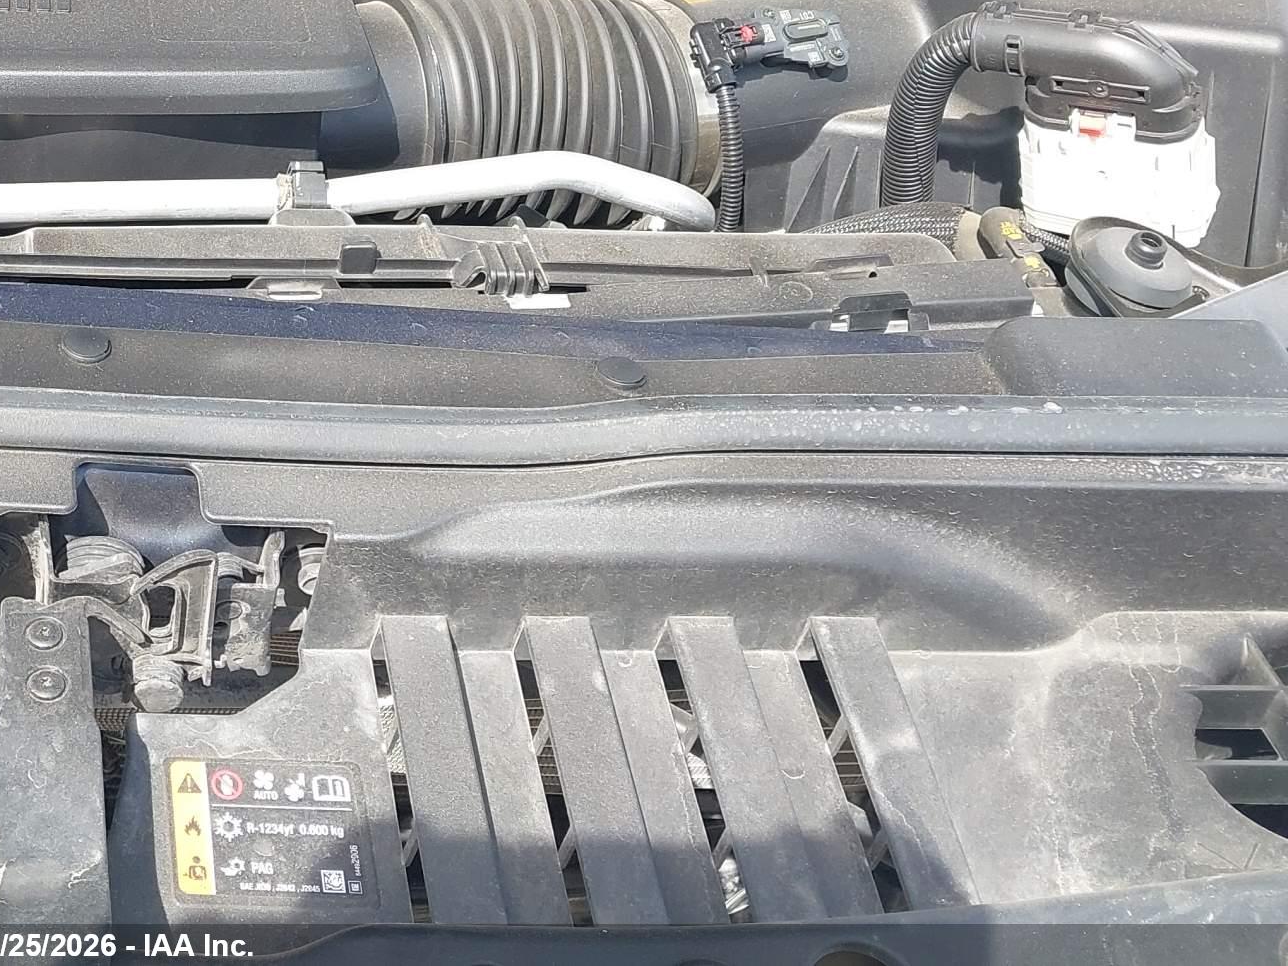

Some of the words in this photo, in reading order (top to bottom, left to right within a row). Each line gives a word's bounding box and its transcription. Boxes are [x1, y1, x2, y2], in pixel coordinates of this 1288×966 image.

[253, 790, 279, 801] AUTO
[246, 821, 294, 836] R-1234yf
[330, 825, 345, 838] kg
[250, 861, 274, 875] PAG
